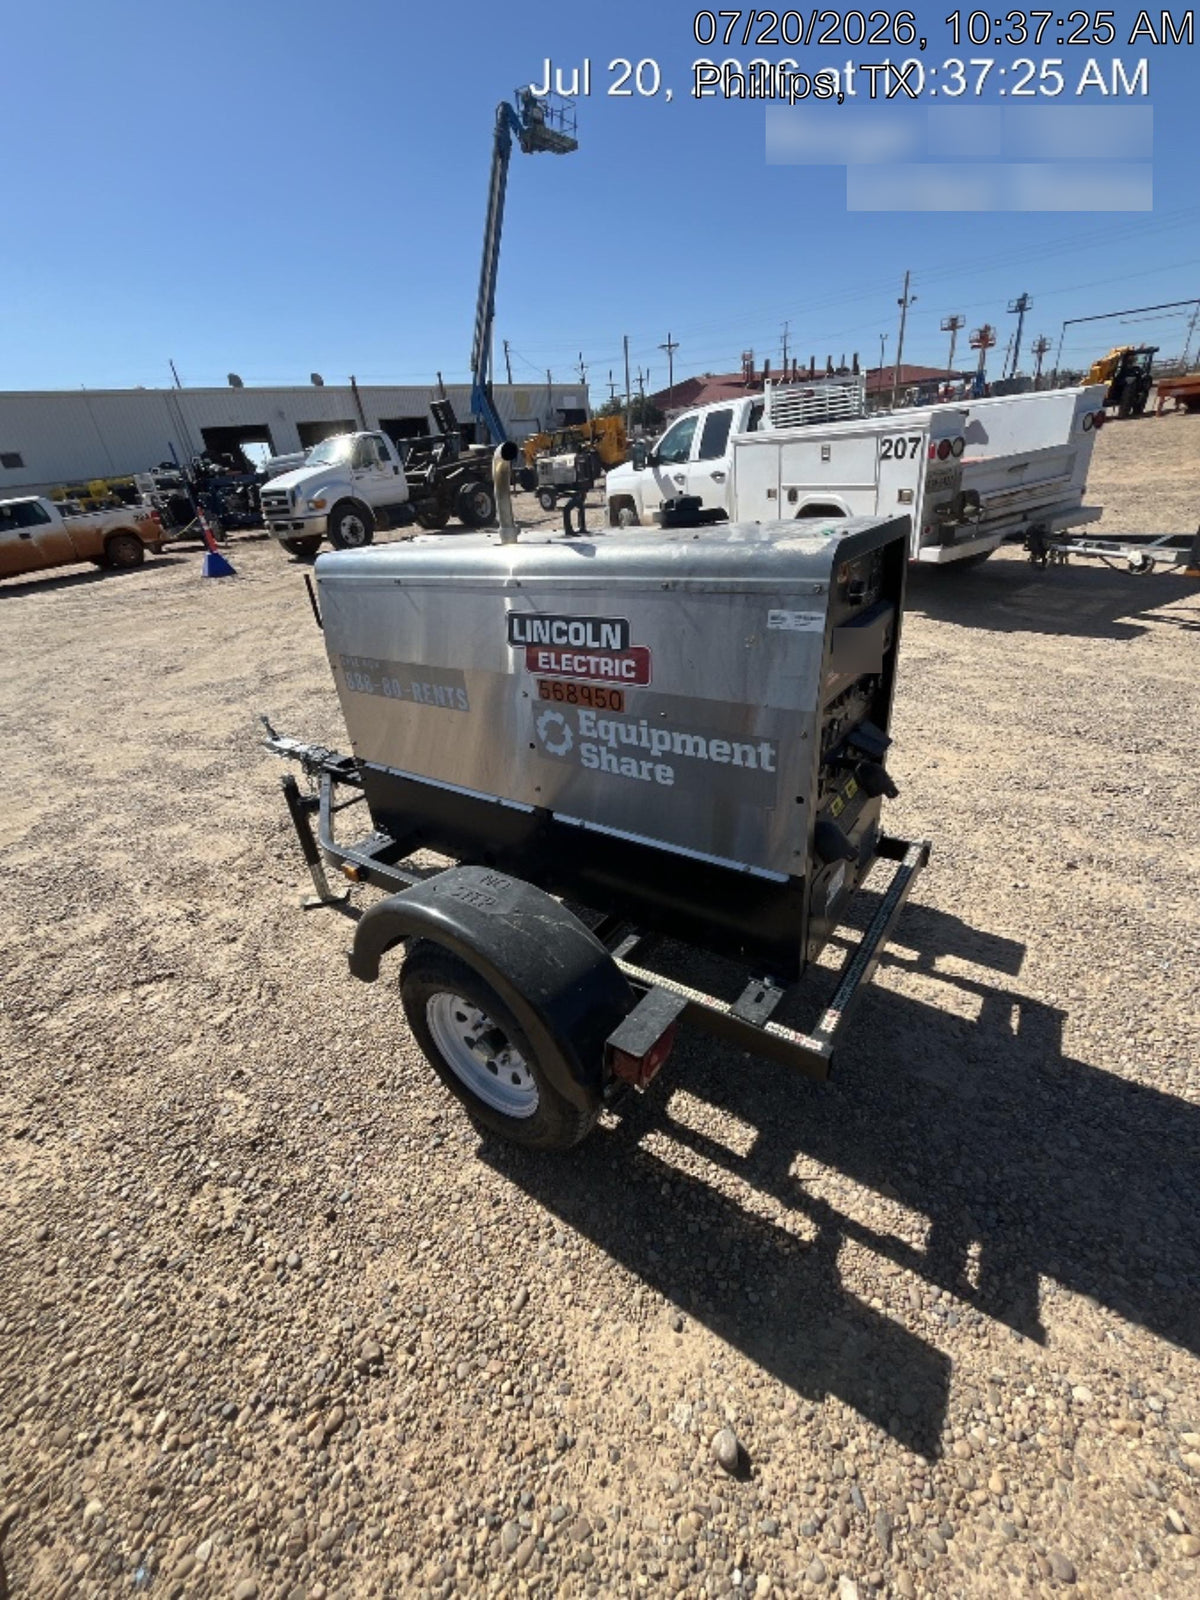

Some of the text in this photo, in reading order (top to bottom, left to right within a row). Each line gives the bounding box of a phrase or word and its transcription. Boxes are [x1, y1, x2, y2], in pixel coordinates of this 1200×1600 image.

[880, 437, 921, 460] 207
[512, 618, 622, 650] LINCOLN
[537, 651, 636, 678] ELECTRIC
[538, 680, 622, 712] 568950
[577, 708, 776, 773] Equipment
[579, 741, 675, 787] Share
